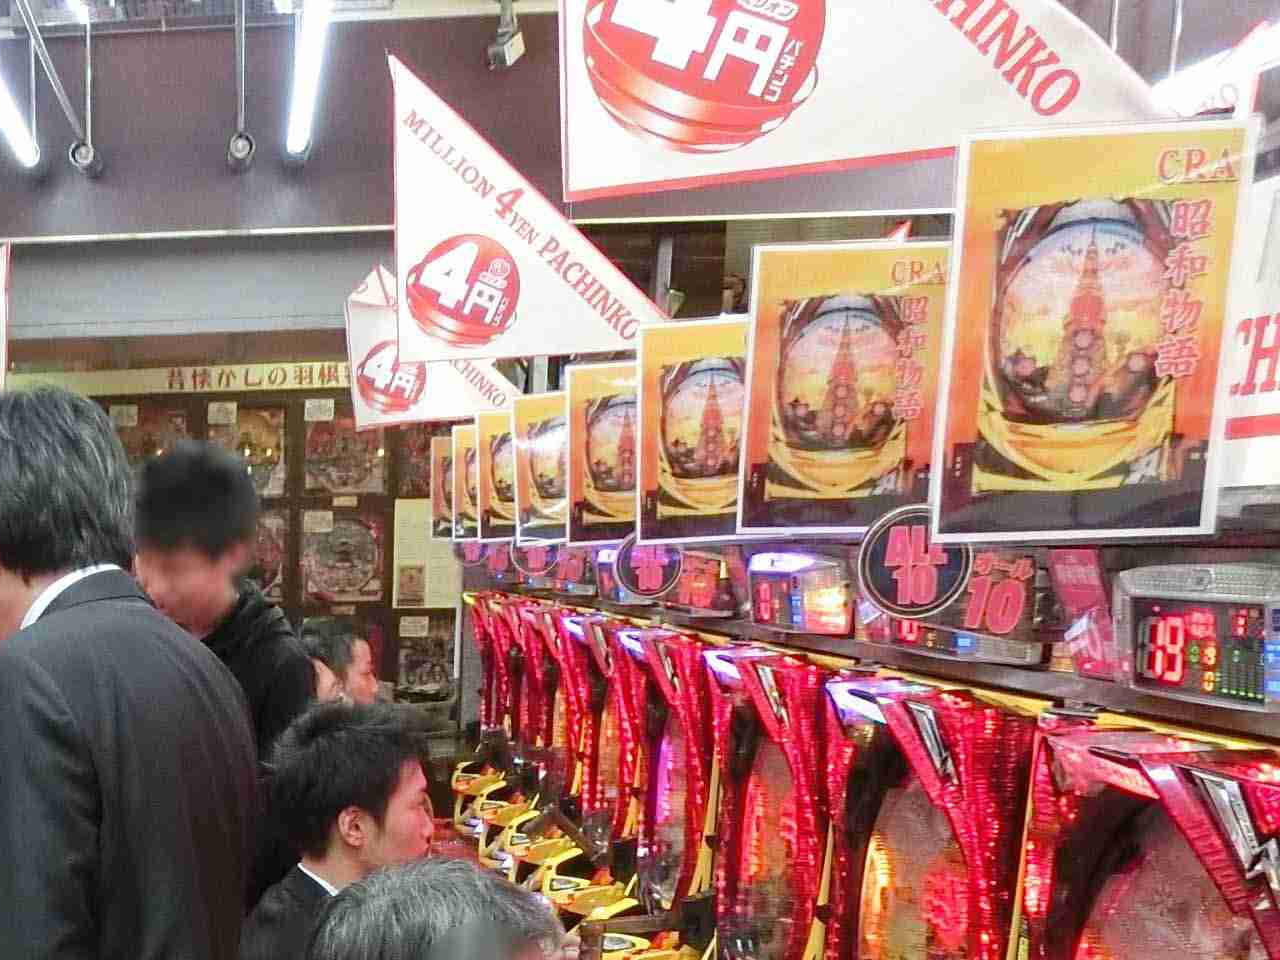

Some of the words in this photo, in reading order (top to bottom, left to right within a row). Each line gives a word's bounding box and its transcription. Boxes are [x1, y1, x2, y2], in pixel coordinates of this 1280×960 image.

[403, 110, 496, 200] MILLION
[1158, 148, 1238, 182] CRA
[495, 187, 524, 219] 4
[508, 210, 540, 246] YEN
[420, 241, 503, 325] 4円
[537, 236, 640, 340] PACHINKO
[890, 259, 945, 285] CRA
[1155, 200, 1213, 378] 昭和物語
[893, 565, 938, 605] 10
[965, 575, 1025, 633] 10
